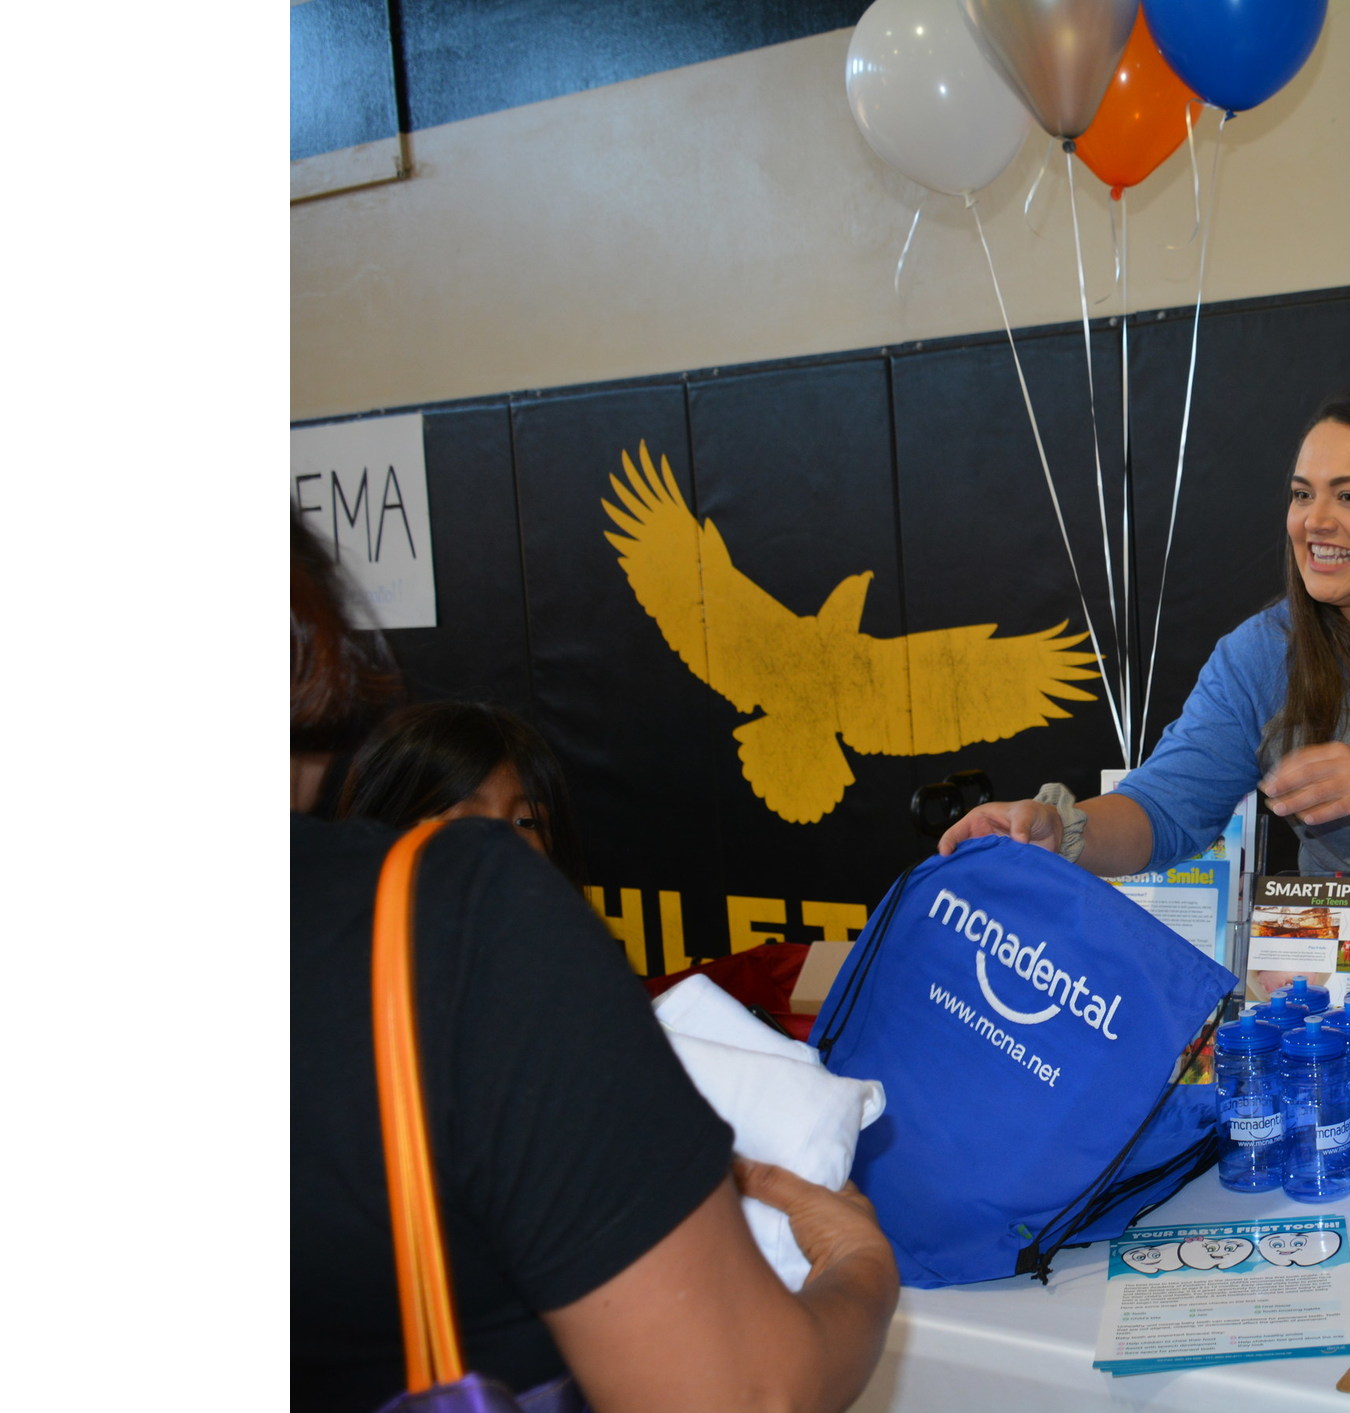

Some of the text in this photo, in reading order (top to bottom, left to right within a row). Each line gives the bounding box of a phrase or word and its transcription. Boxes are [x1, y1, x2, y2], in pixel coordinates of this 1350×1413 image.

[1166, 866, 1215, 885] Smile!
[1265, 881, 1323, 897] SMART
[1326, 898, 1348, 906] Teens
[928, 887, 1122, 1041] mcnadental
[929, 982, 1061, 1088] www.mcna.net
[1132, 1221, 1340, 1239] YOUR BABY'S FIRST TOOTH!
